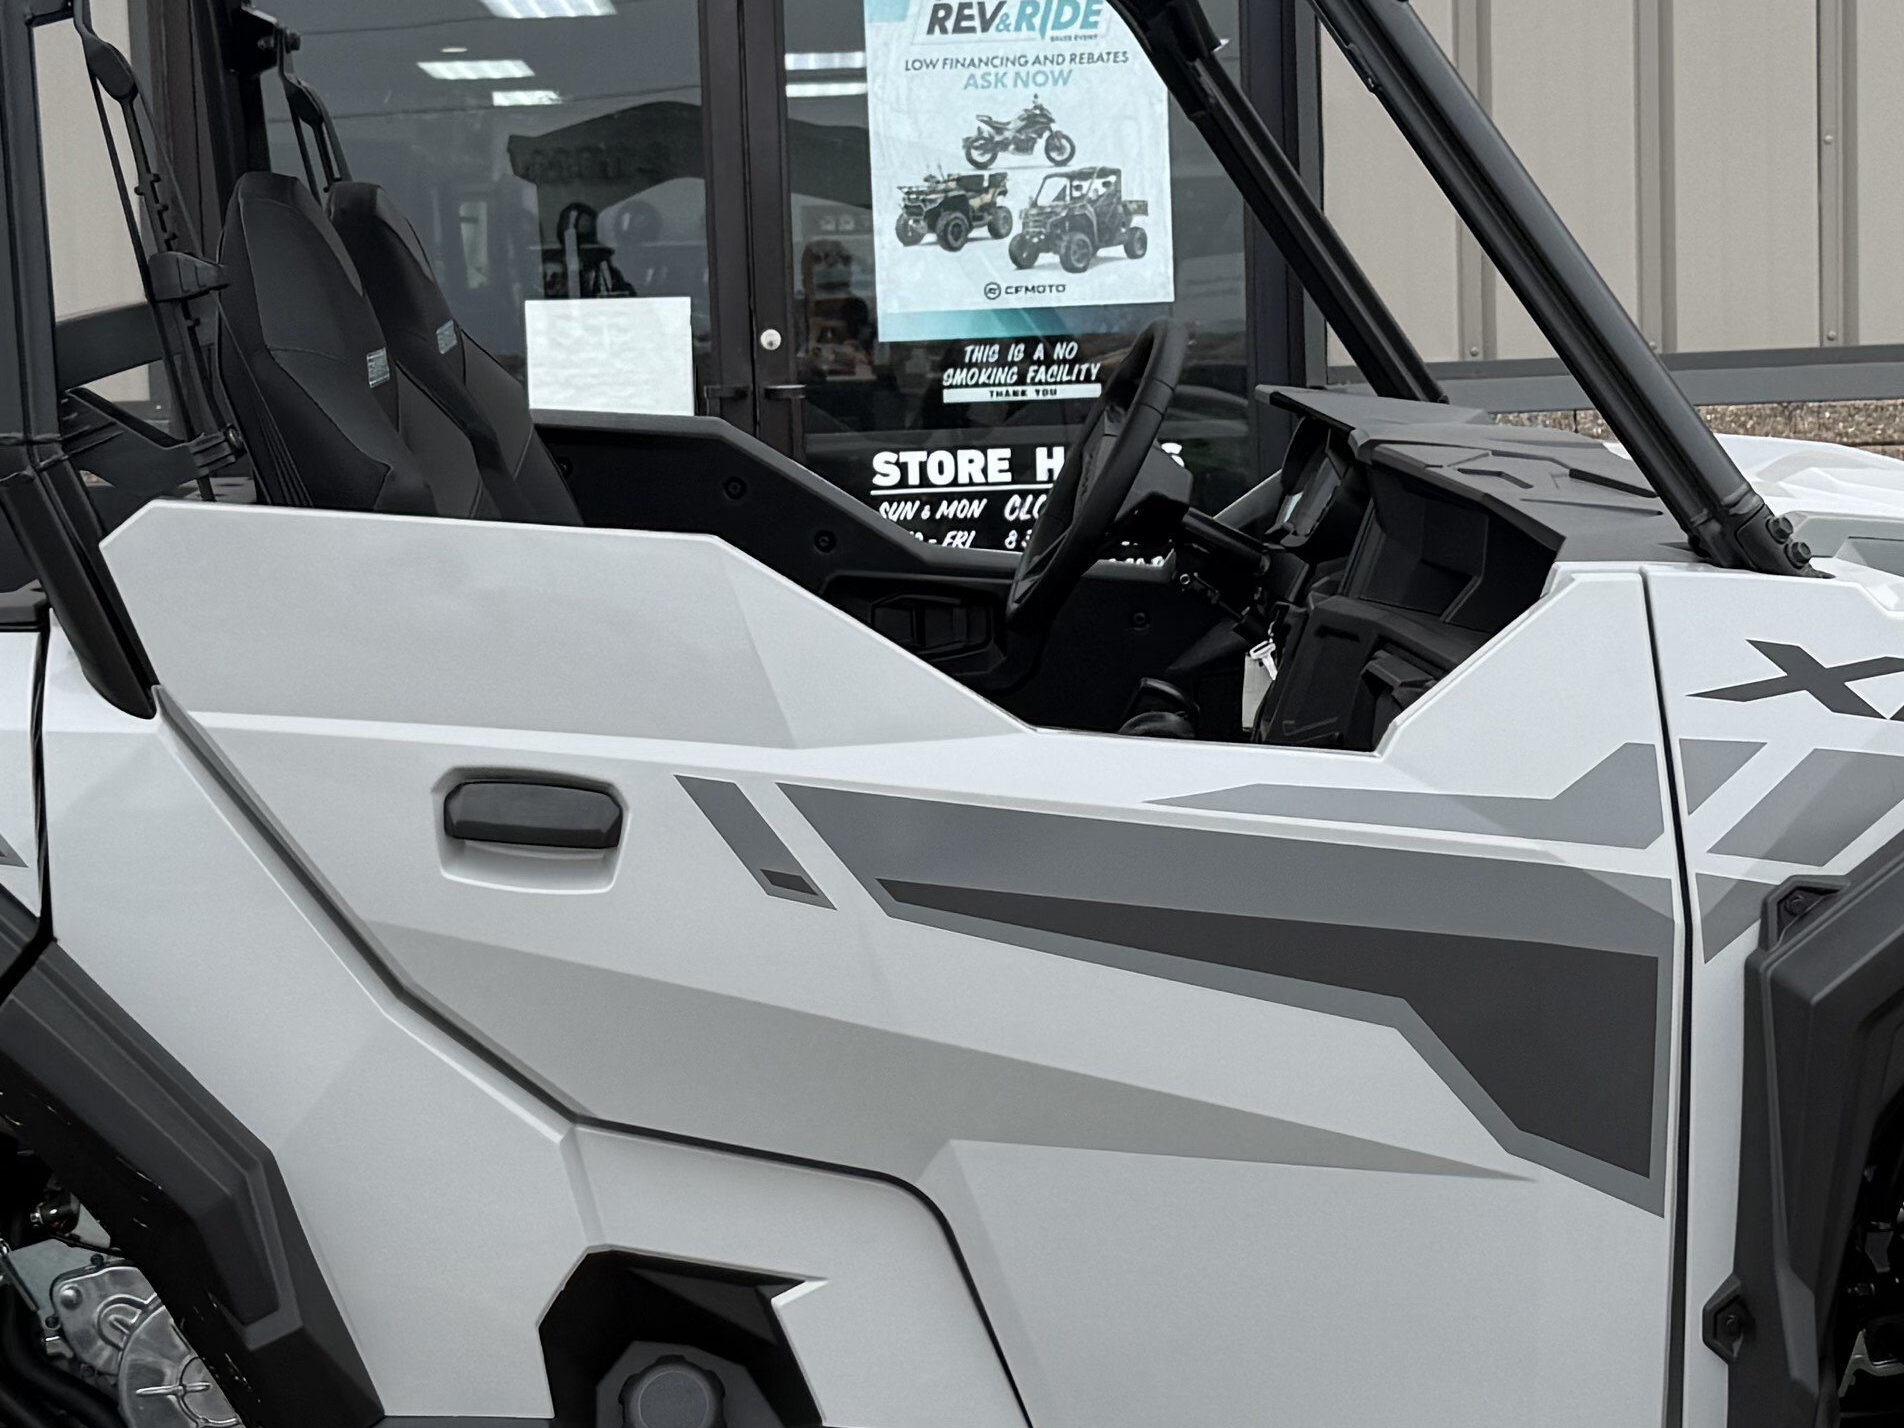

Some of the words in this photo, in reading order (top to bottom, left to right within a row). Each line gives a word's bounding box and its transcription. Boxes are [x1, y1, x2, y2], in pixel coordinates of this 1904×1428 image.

[904, 58, 940, 72] LOW
[941, 53, 1030, 70] FINANCING
[1031, 53, 1066, 67] AND
[1068, 50, 1130, 65] REBATES
[963, 71, 1009, 91] ASK
[1012, 69, 1074, 89] NOW
[1004, 283, 1067, 296] CFMOTO
[963, 343, 1001, 364] THIS
[1007, 343, 1026, 363] IS
[1033, 342, 1045, 362] A
[1053, 341, 1079, 360] NO
[942, 365, 1019, 387] SMOKING
[1026, 362, 1102, 384] FACILITY
[988, 389, 1028, 399] THANK
[1034, 388, 1058, 398] YOU
[871, 447, 1013, 487] STORE
[935, 497, 988, 520] MON
[941, 529, 976, 549] FRI
